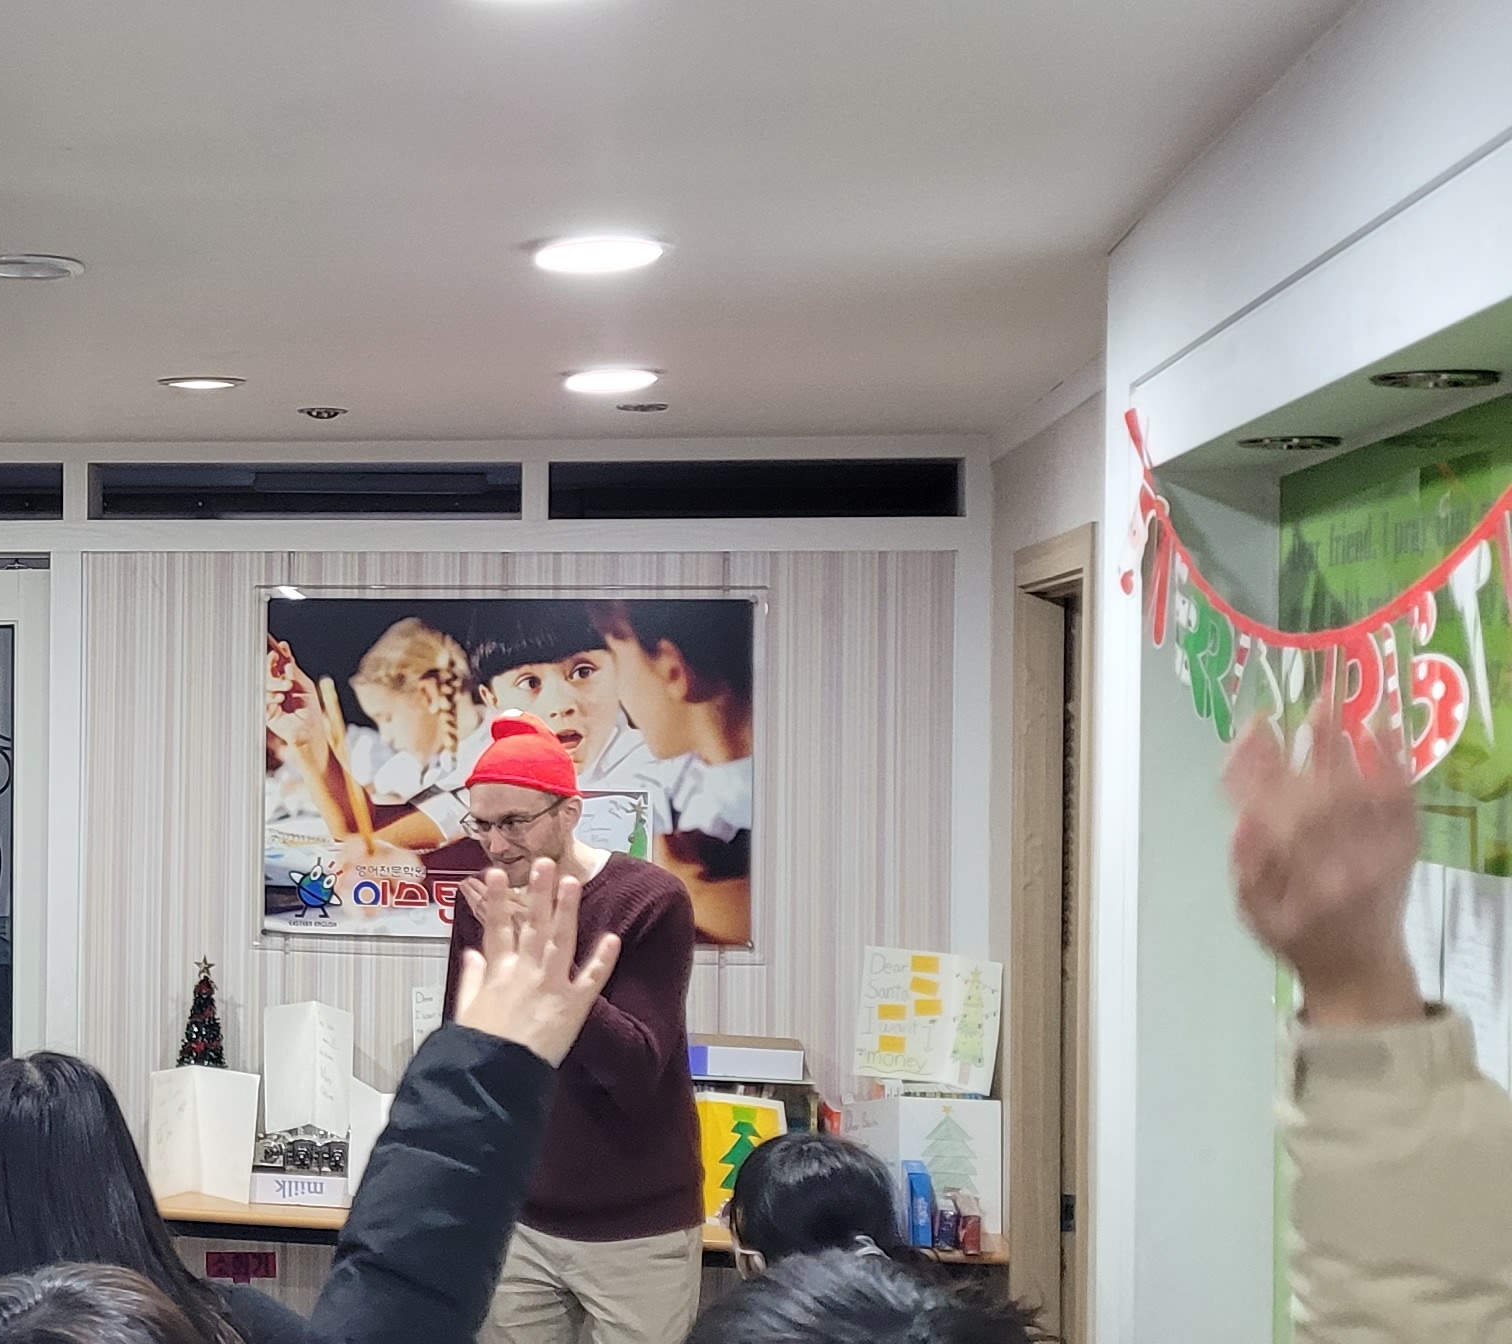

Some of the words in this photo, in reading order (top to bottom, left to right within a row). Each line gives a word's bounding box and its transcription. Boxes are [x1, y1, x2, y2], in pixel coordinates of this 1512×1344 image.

[870, 952, 907, 975] Dear
[865, 979, 909, 1002] Santa
[861, 1006, 875, 1035] I
[878, 1019, 919, 1035] want
[865, 1050, 927, 1071] money
[274, 1179, 326, 1199] miilk
